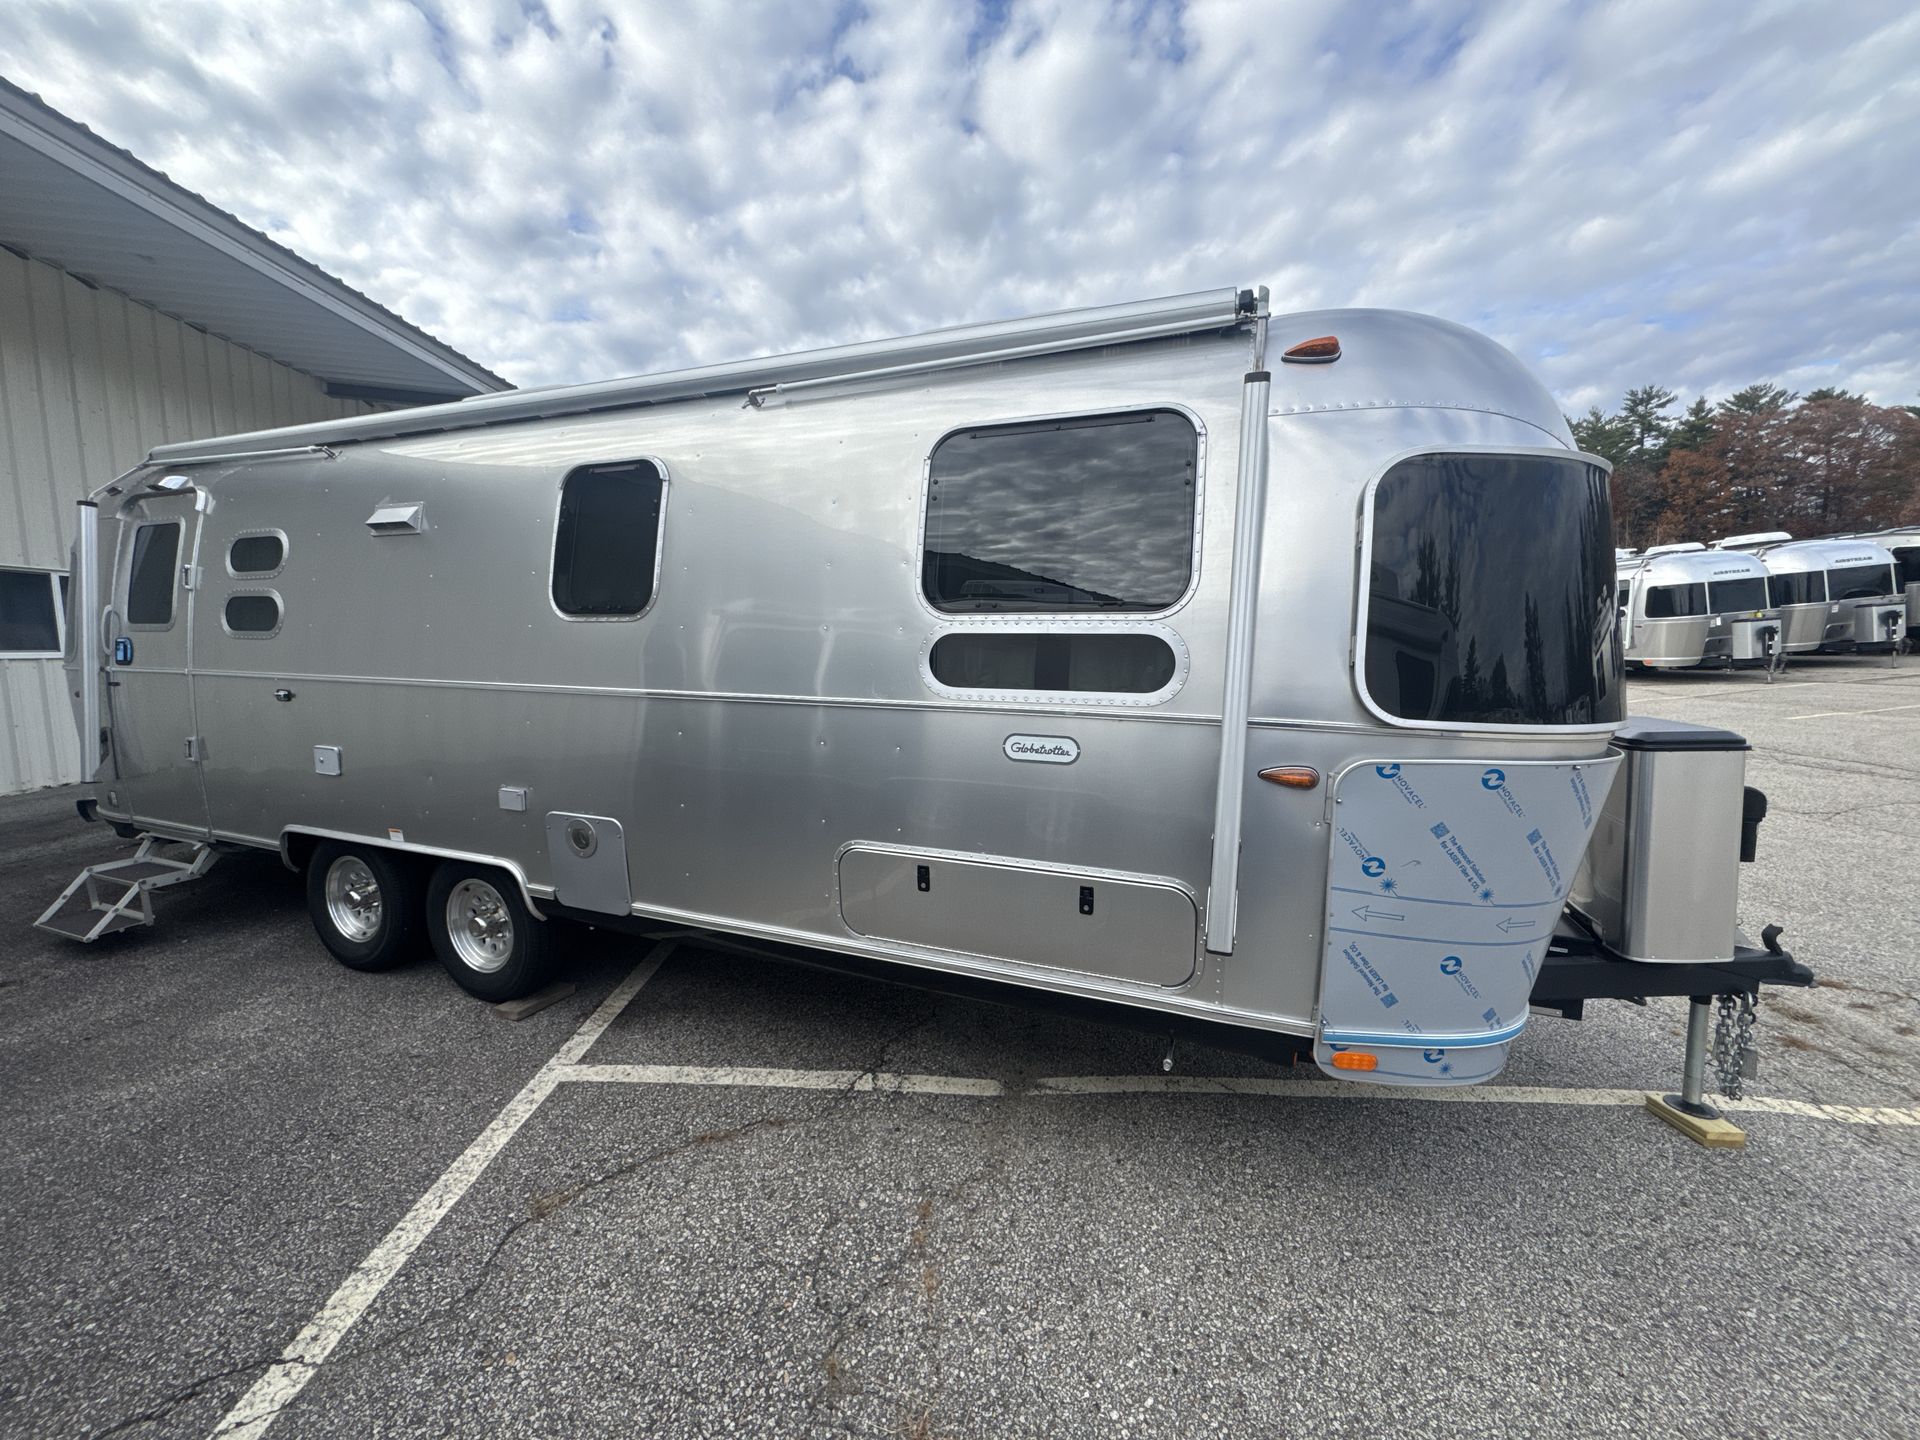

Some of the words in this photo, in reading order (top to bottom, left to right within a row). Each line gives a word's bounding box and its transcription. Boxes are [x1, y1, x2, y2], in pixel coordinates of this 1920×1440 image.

[1713, 568, 1751, 576] AIRSTREAM
[1010, 742, 1072, 756] Globetrotter
[1395, 774, 1424, 808] NOVACEL
[1500, 785, 1524, 817] NOVACEL
